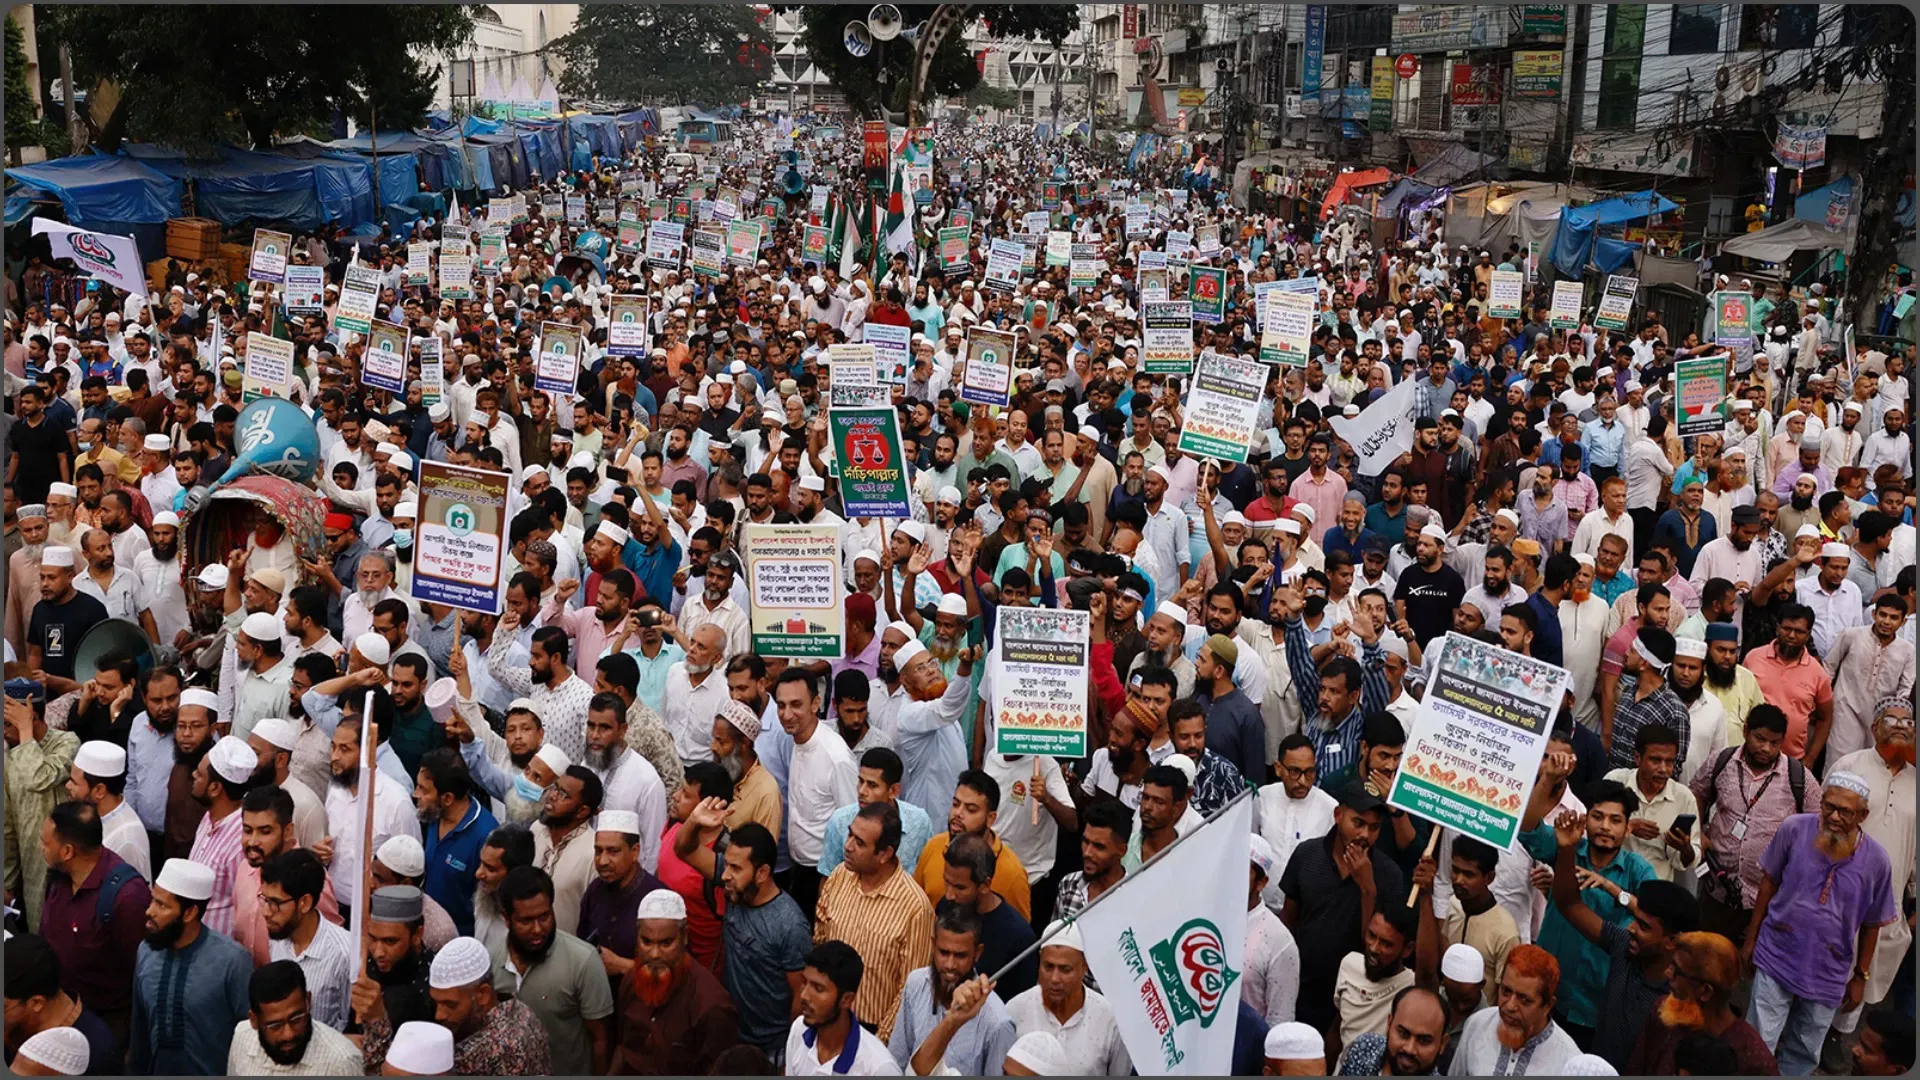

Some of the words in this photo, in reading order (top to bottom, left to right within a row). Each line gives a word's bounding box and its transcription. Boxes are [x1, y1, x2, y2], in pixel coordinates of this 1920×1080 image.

[843, 466, 899, 482] দাঁড়িপাল্লার
[810, 536, 834, 544] ইসলামীর
[48, 629, 61, 651] 2
[1440, 674, 1475, 692] বাংলাদেশ
[1476, 685, 1512, 706] জামায়াতে
[1513, 696, 1546, 719] ইসলামীর
[1432, 700, 1466, 721] ফ্যাসিস্ট
[1467, 712, 1509, 737] সরকারের
[1511, 729, 1536, 747] সকল
[1446, 722, 1512, 754] জুলুম-নির্যাতন
[1416, 740, 1441, 760] বিচার
[1443, 749, 1477, 772] দৃশ্যমান
[1478, 764, 1504, 782] করতে
[1505, 775, 1524, 791] হবে
[1433, 731, 1468, 752] গণহত্যা
[1469, 746, 1478, 757] ও
[1481, 746, 1516, 772] দুর্নীতির
[1403, 781, 1441, 802] বাংলাদেশ
[1441, 794, 1478, 816] জামায়াতে
[1478, 807, 1510, 831] ইসলামী
[1118, 926, 1147, 982] বাংলাদেশ
[1140, 977, 1170, 1035] জামায়াতে
